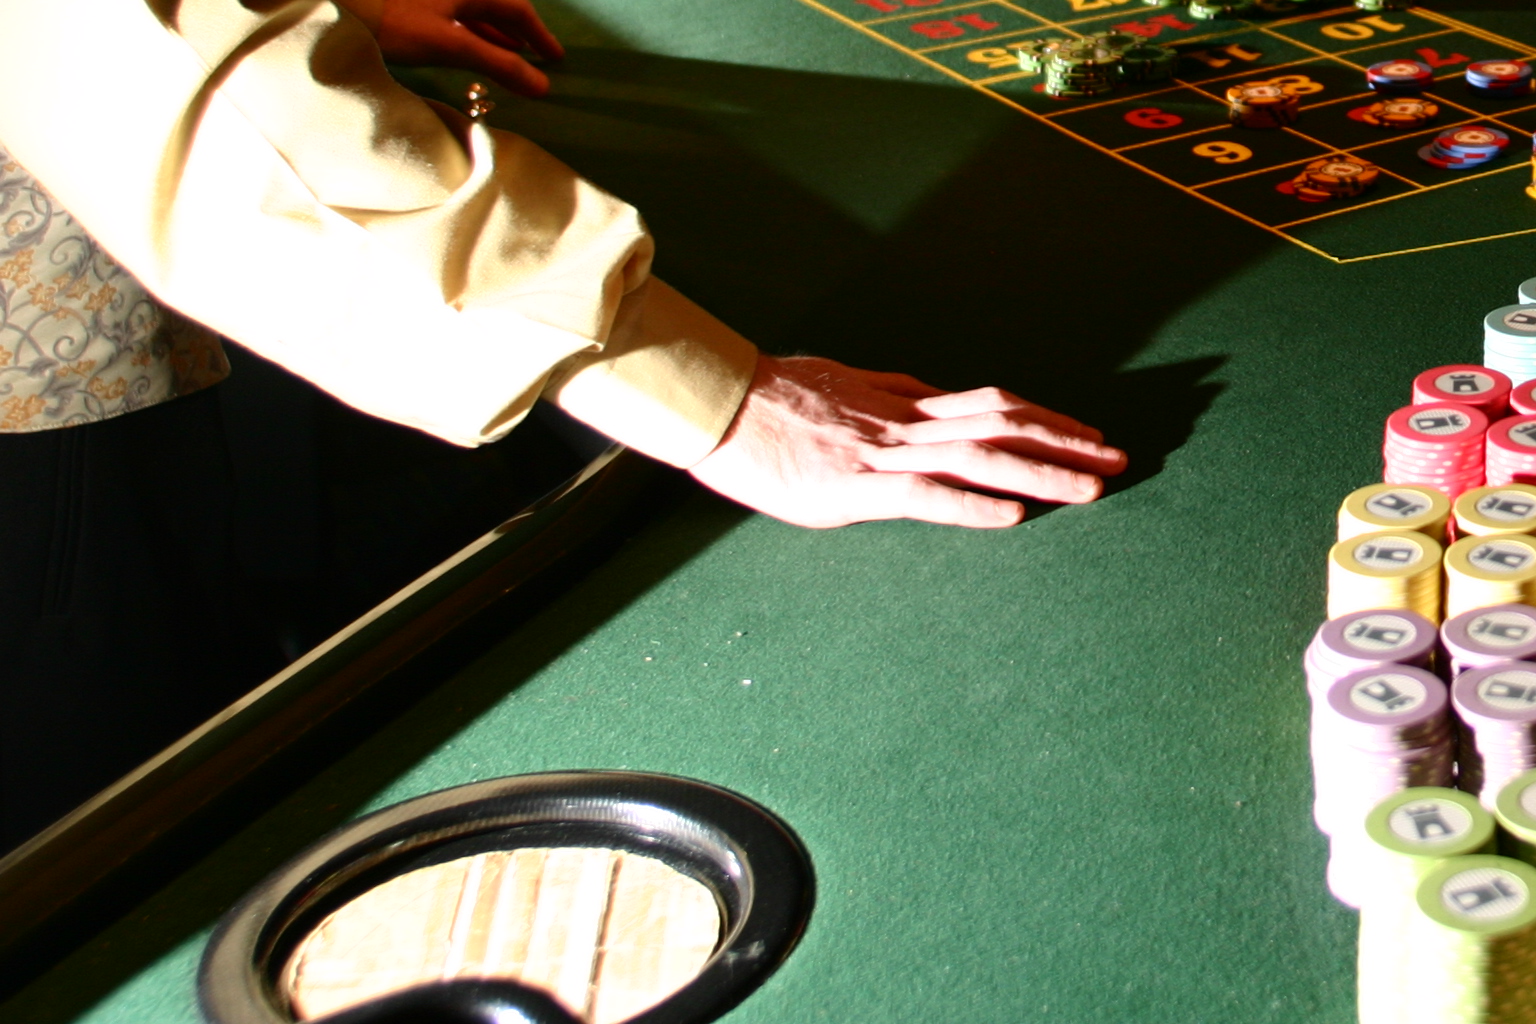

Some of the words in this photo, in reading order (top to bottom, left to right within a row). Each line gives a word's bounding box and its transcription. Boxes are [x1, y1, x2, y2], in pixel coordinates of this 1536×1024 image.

[910, 13, 1000, 39] 18
[1319, 15, 1405, 41] 10
[1415, 47, 1471, 68] 7
[1124, 107, 1184, 129] 9
[1192, 140, 1253, 164] 6
